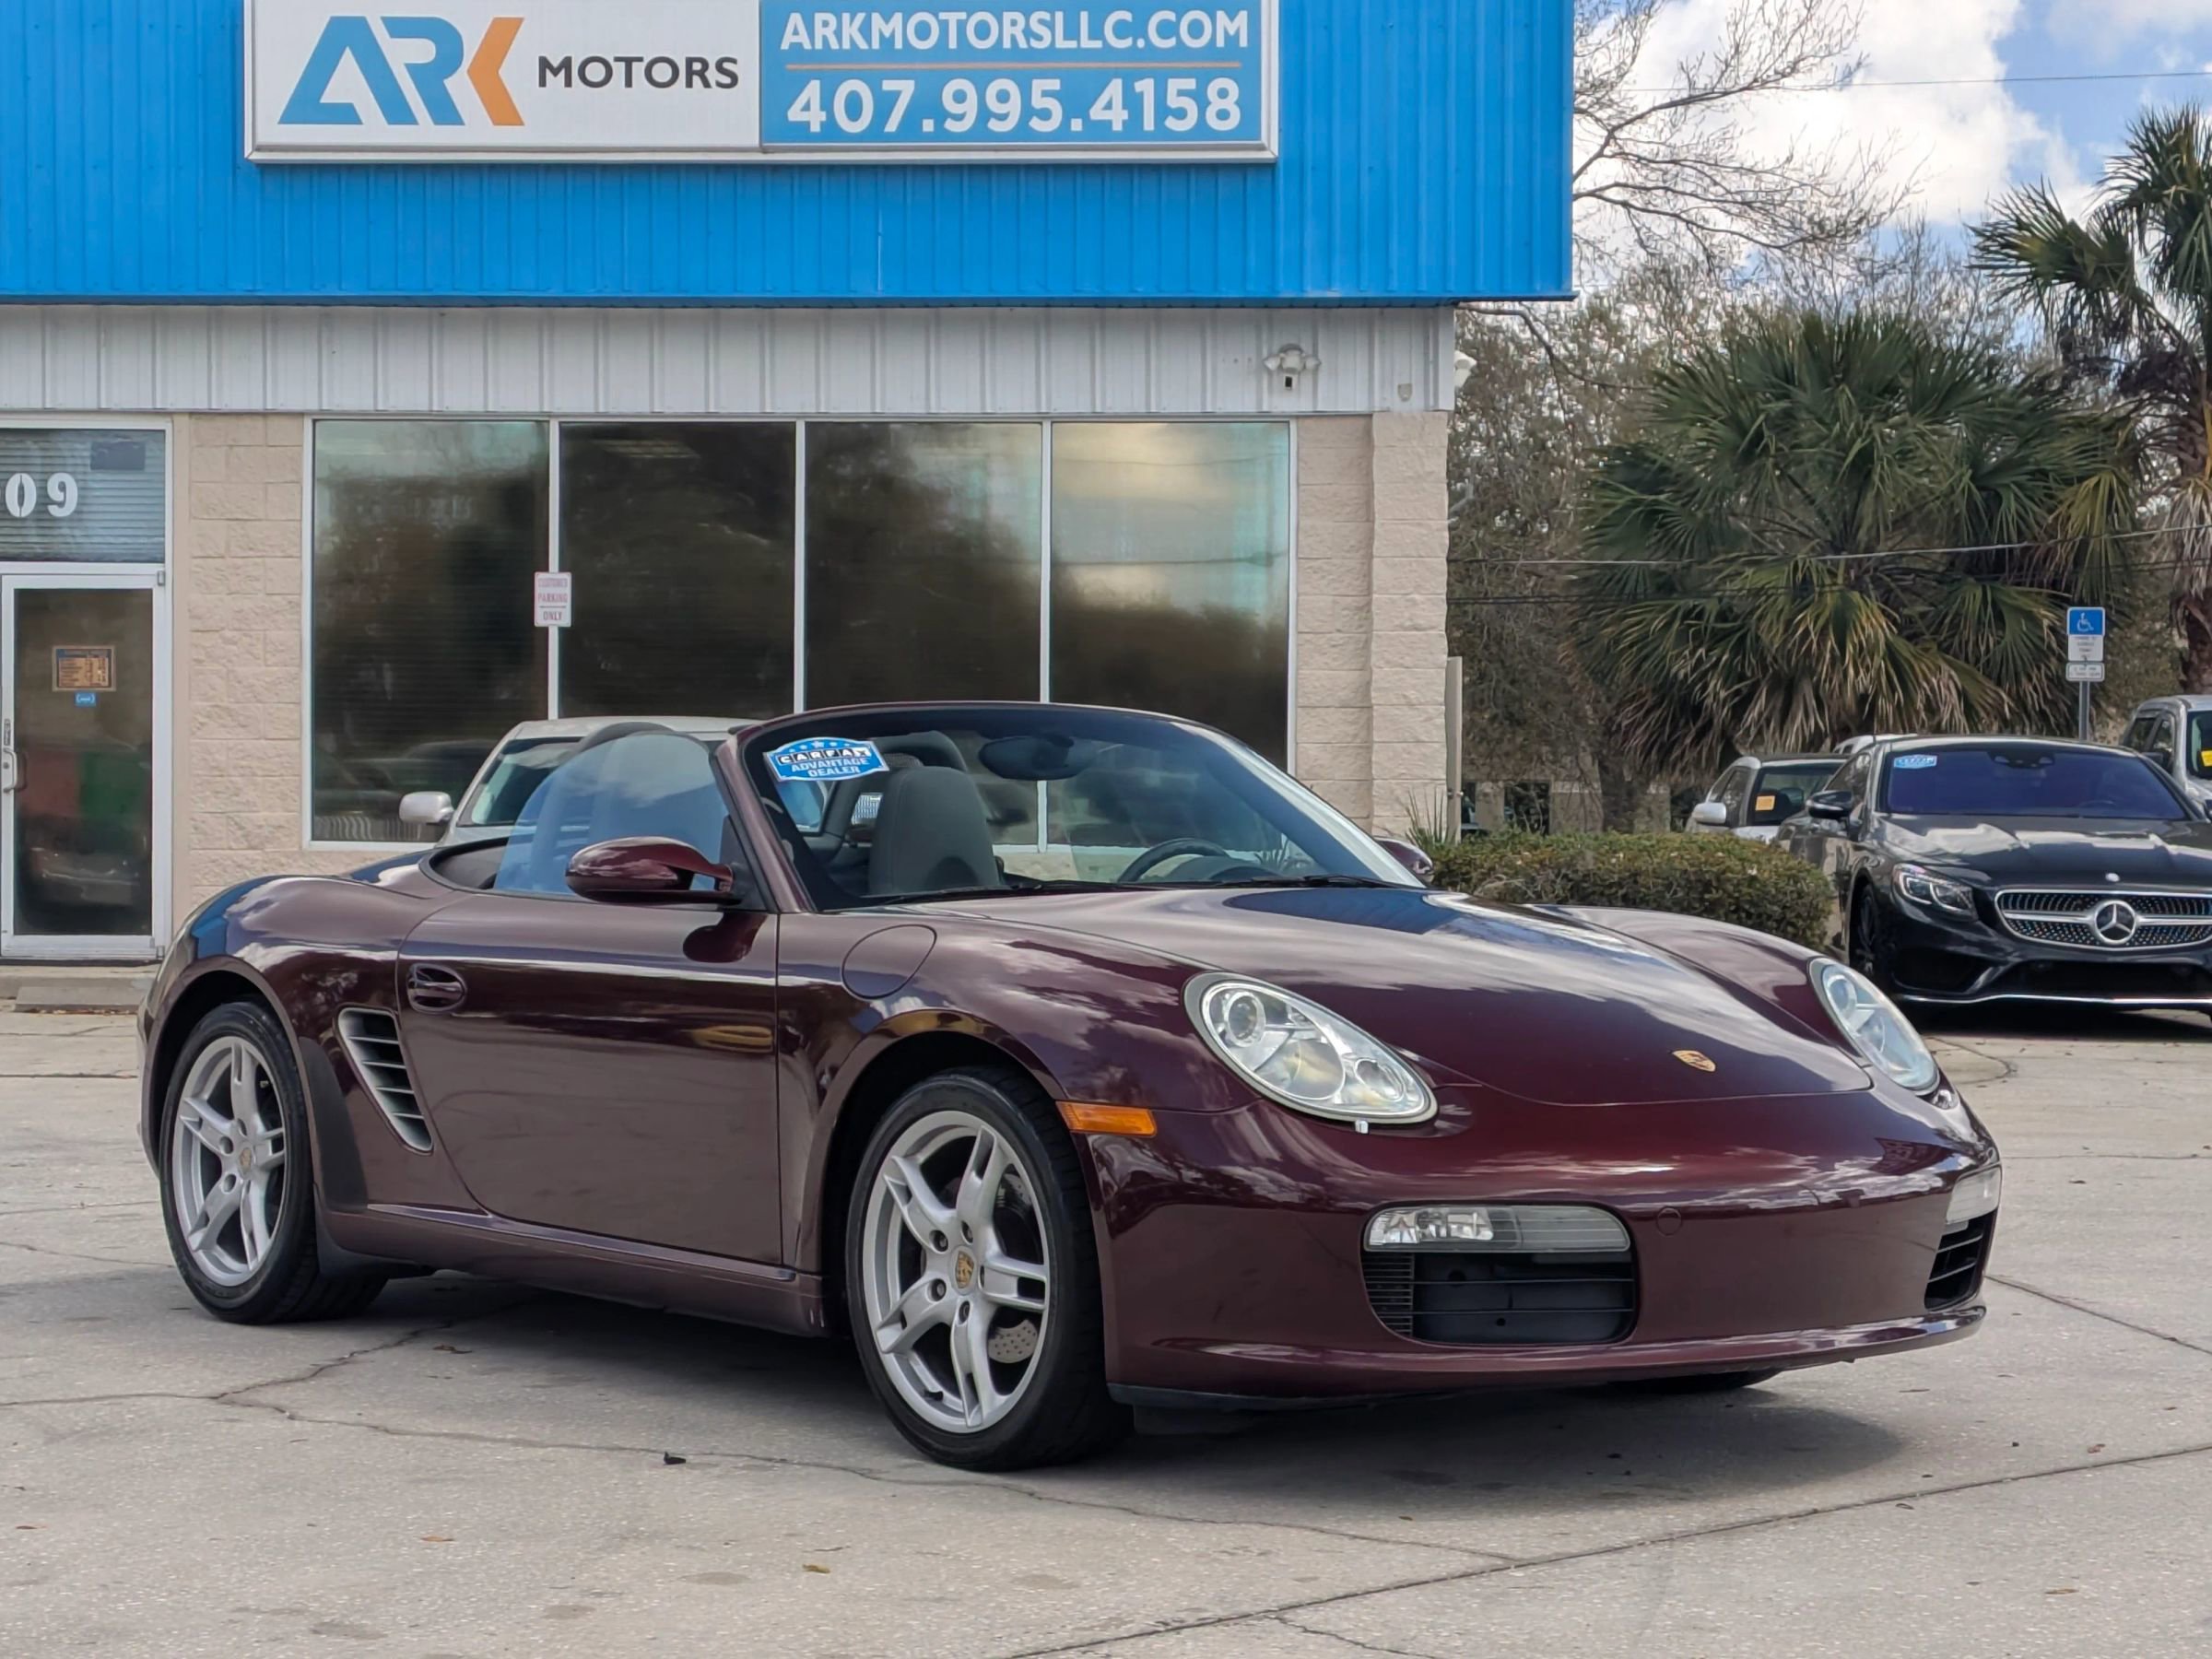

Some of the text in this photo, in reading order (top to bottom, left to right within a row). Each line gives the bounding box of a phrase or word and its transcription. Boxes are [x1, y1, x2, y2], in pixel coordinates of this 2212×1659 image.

[781, 9, 1248, 51] ARKMOTORSLLC.COM
[277, 16, 738, 126] ARK MOTORS
[787, 77, 1241, 133] 407.995.4158
[537, 593, 569, 603] PARKING
[543, 610, 562, 620] ONLY
[778, 747, 871, 764] CARFAX
[791, 758, 870, 772] ADVANTAGE
[807, 766, 861, 777] DEALER
